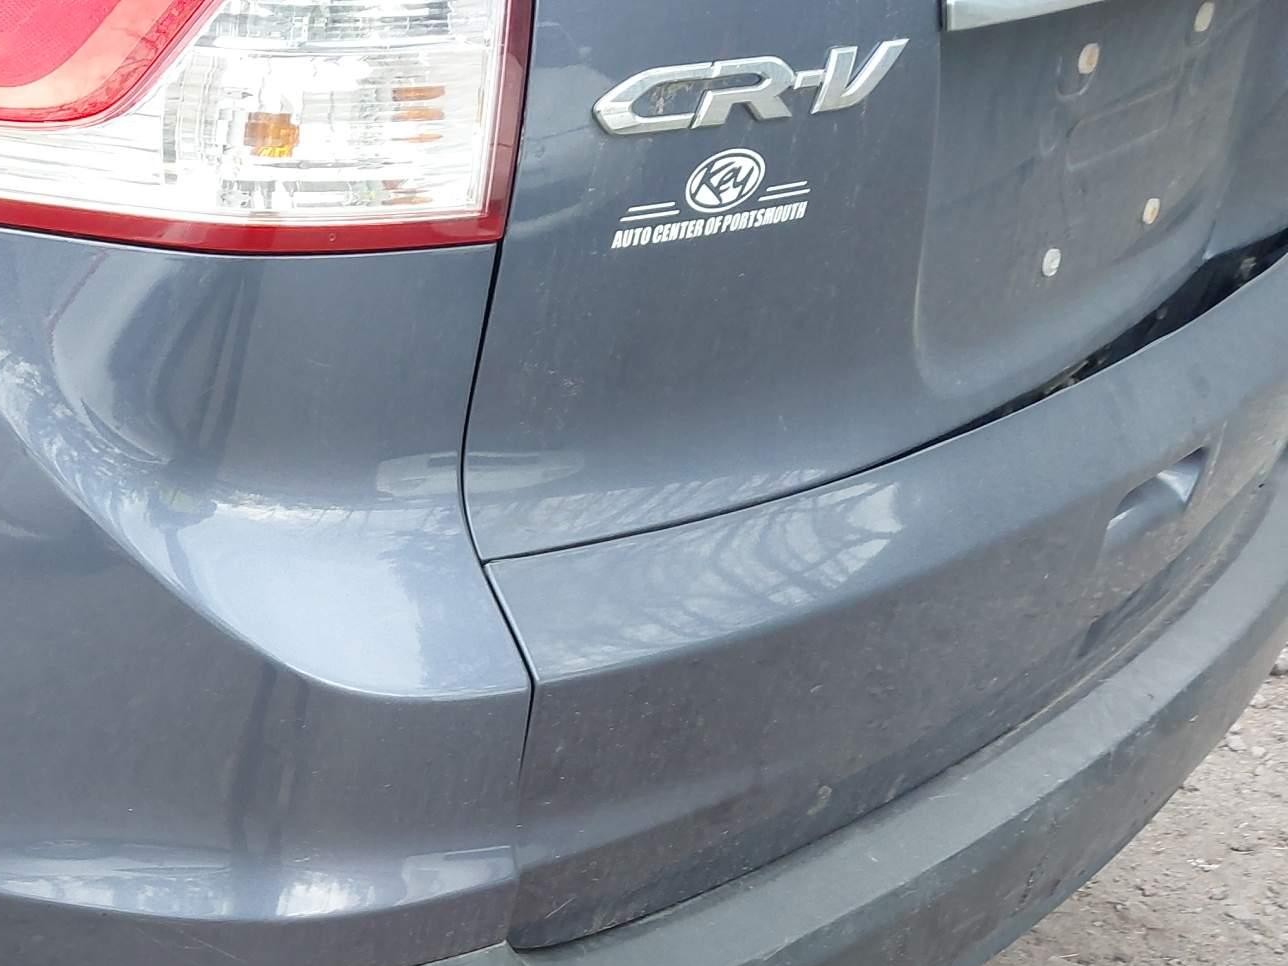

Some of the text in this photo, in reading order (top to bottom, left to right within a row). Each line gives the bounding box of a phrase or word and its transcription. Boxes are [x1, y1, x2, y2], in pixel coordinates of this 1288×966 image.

[592, 38, 910, 135] CR-V
[611, 201, 808, 248] AUTO CENTER OF PORTSMOUTH
